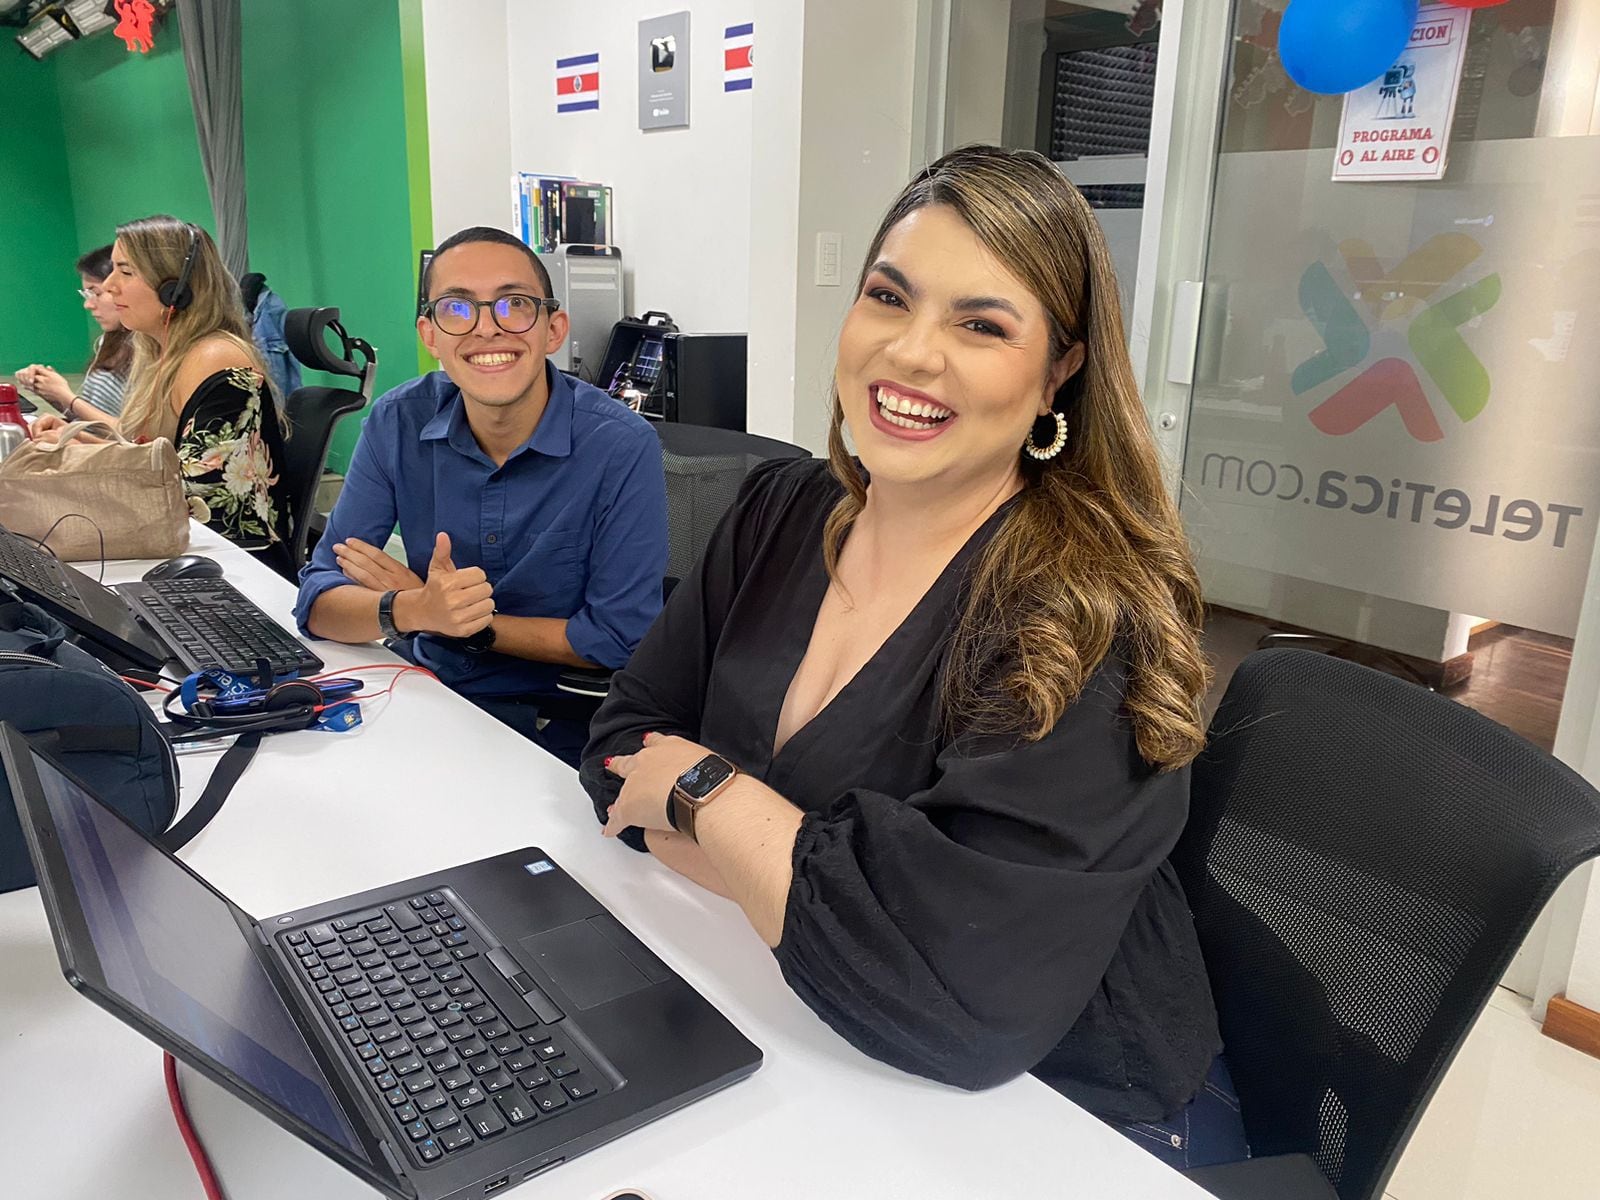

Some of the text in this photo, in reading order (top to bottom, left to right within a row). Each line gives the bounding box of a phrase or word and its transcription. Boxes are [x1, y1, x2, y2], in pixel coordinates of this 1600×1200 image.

[1410, 25, 1449, 42] CION
[1352, 127, 1433, 143] PROGRAMA
[1360, 148, 1416, 162] AL AIRE
